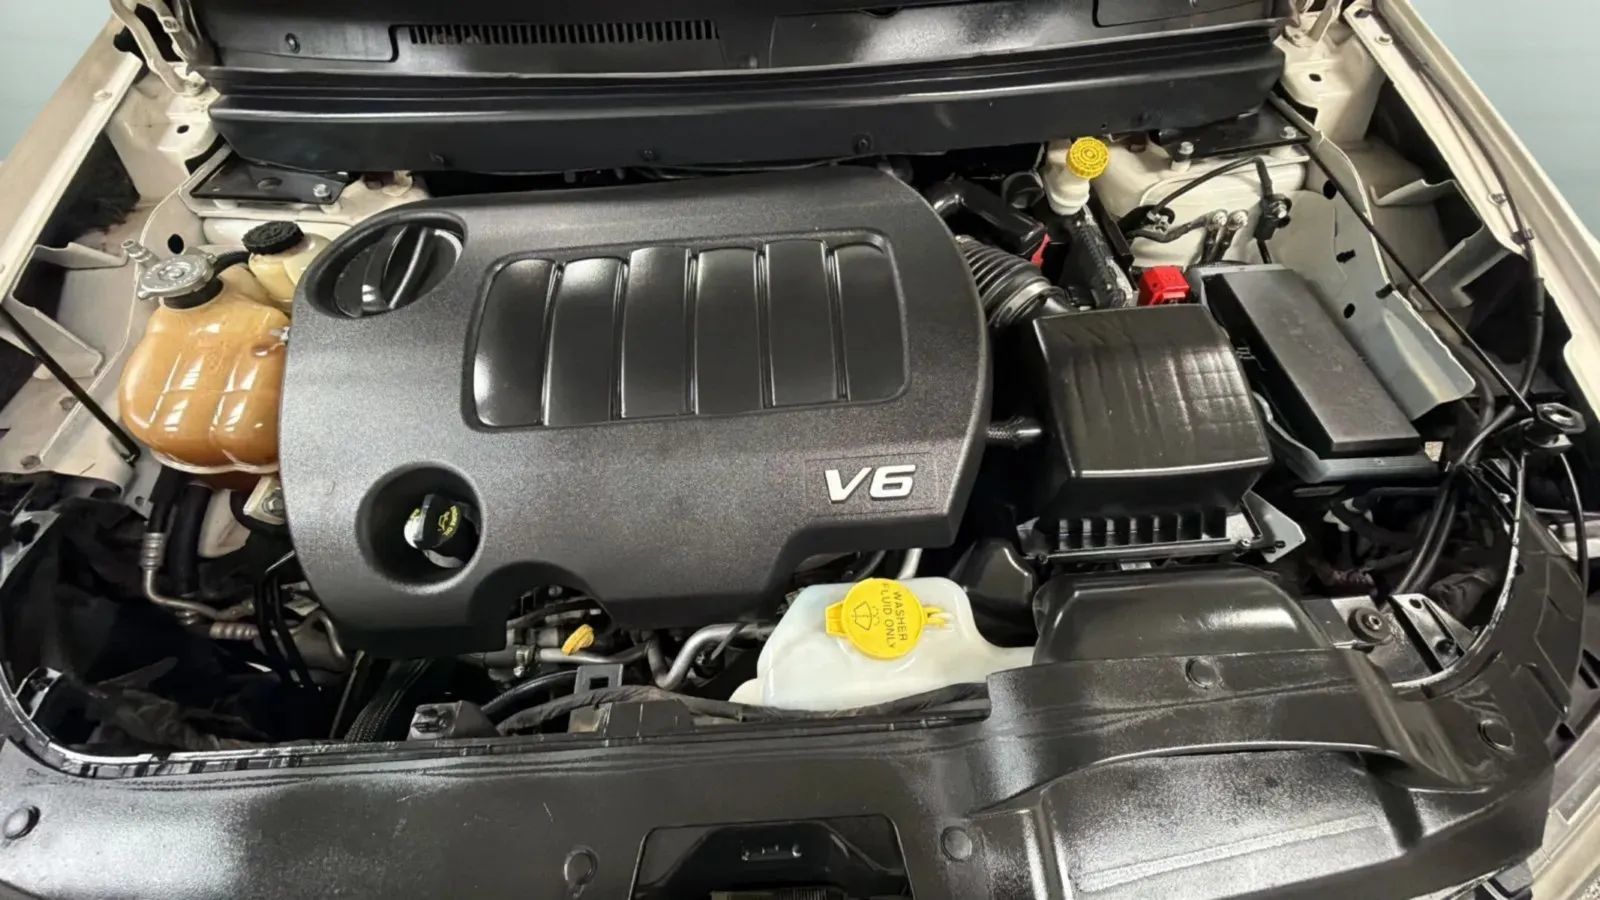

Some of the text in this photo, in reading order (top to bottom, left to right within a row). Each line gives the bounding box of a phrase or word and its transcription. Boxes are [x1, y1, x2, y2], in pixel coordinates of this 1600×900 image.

[824, 464, 917, 503] V6
[880, 582, 896, 649] FLUID ONLY
[893, 591, 908, 641] WASHER
